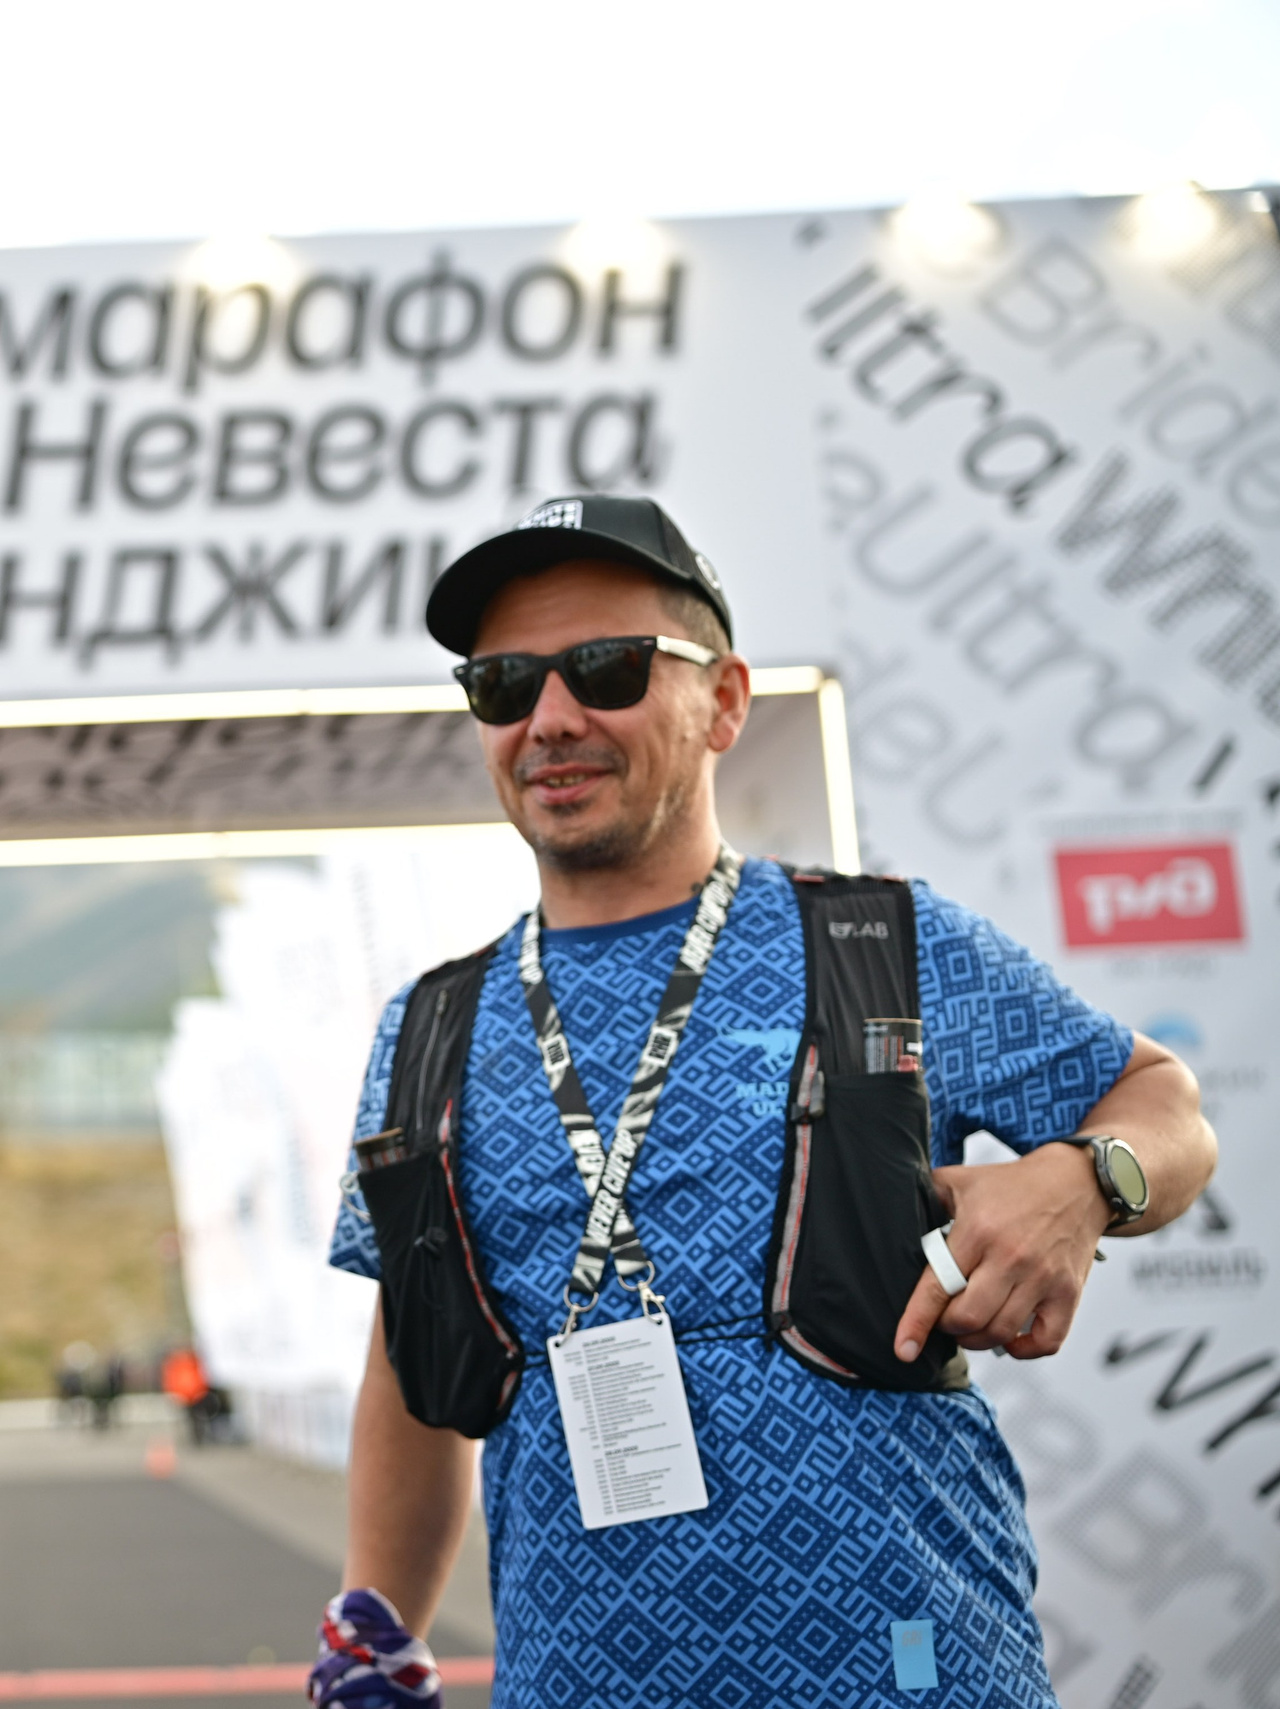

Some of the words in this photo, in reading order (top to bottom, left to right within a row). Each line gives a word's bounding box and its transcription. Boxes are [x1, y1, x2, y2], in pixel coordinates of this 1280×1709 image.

[1, 390, 664, 518] Невеста
[611, 1128, 638, 1159] UP
[601, 1150, 631, 1195] GIVE
[585, 1188, 621, 1243] NEVER
